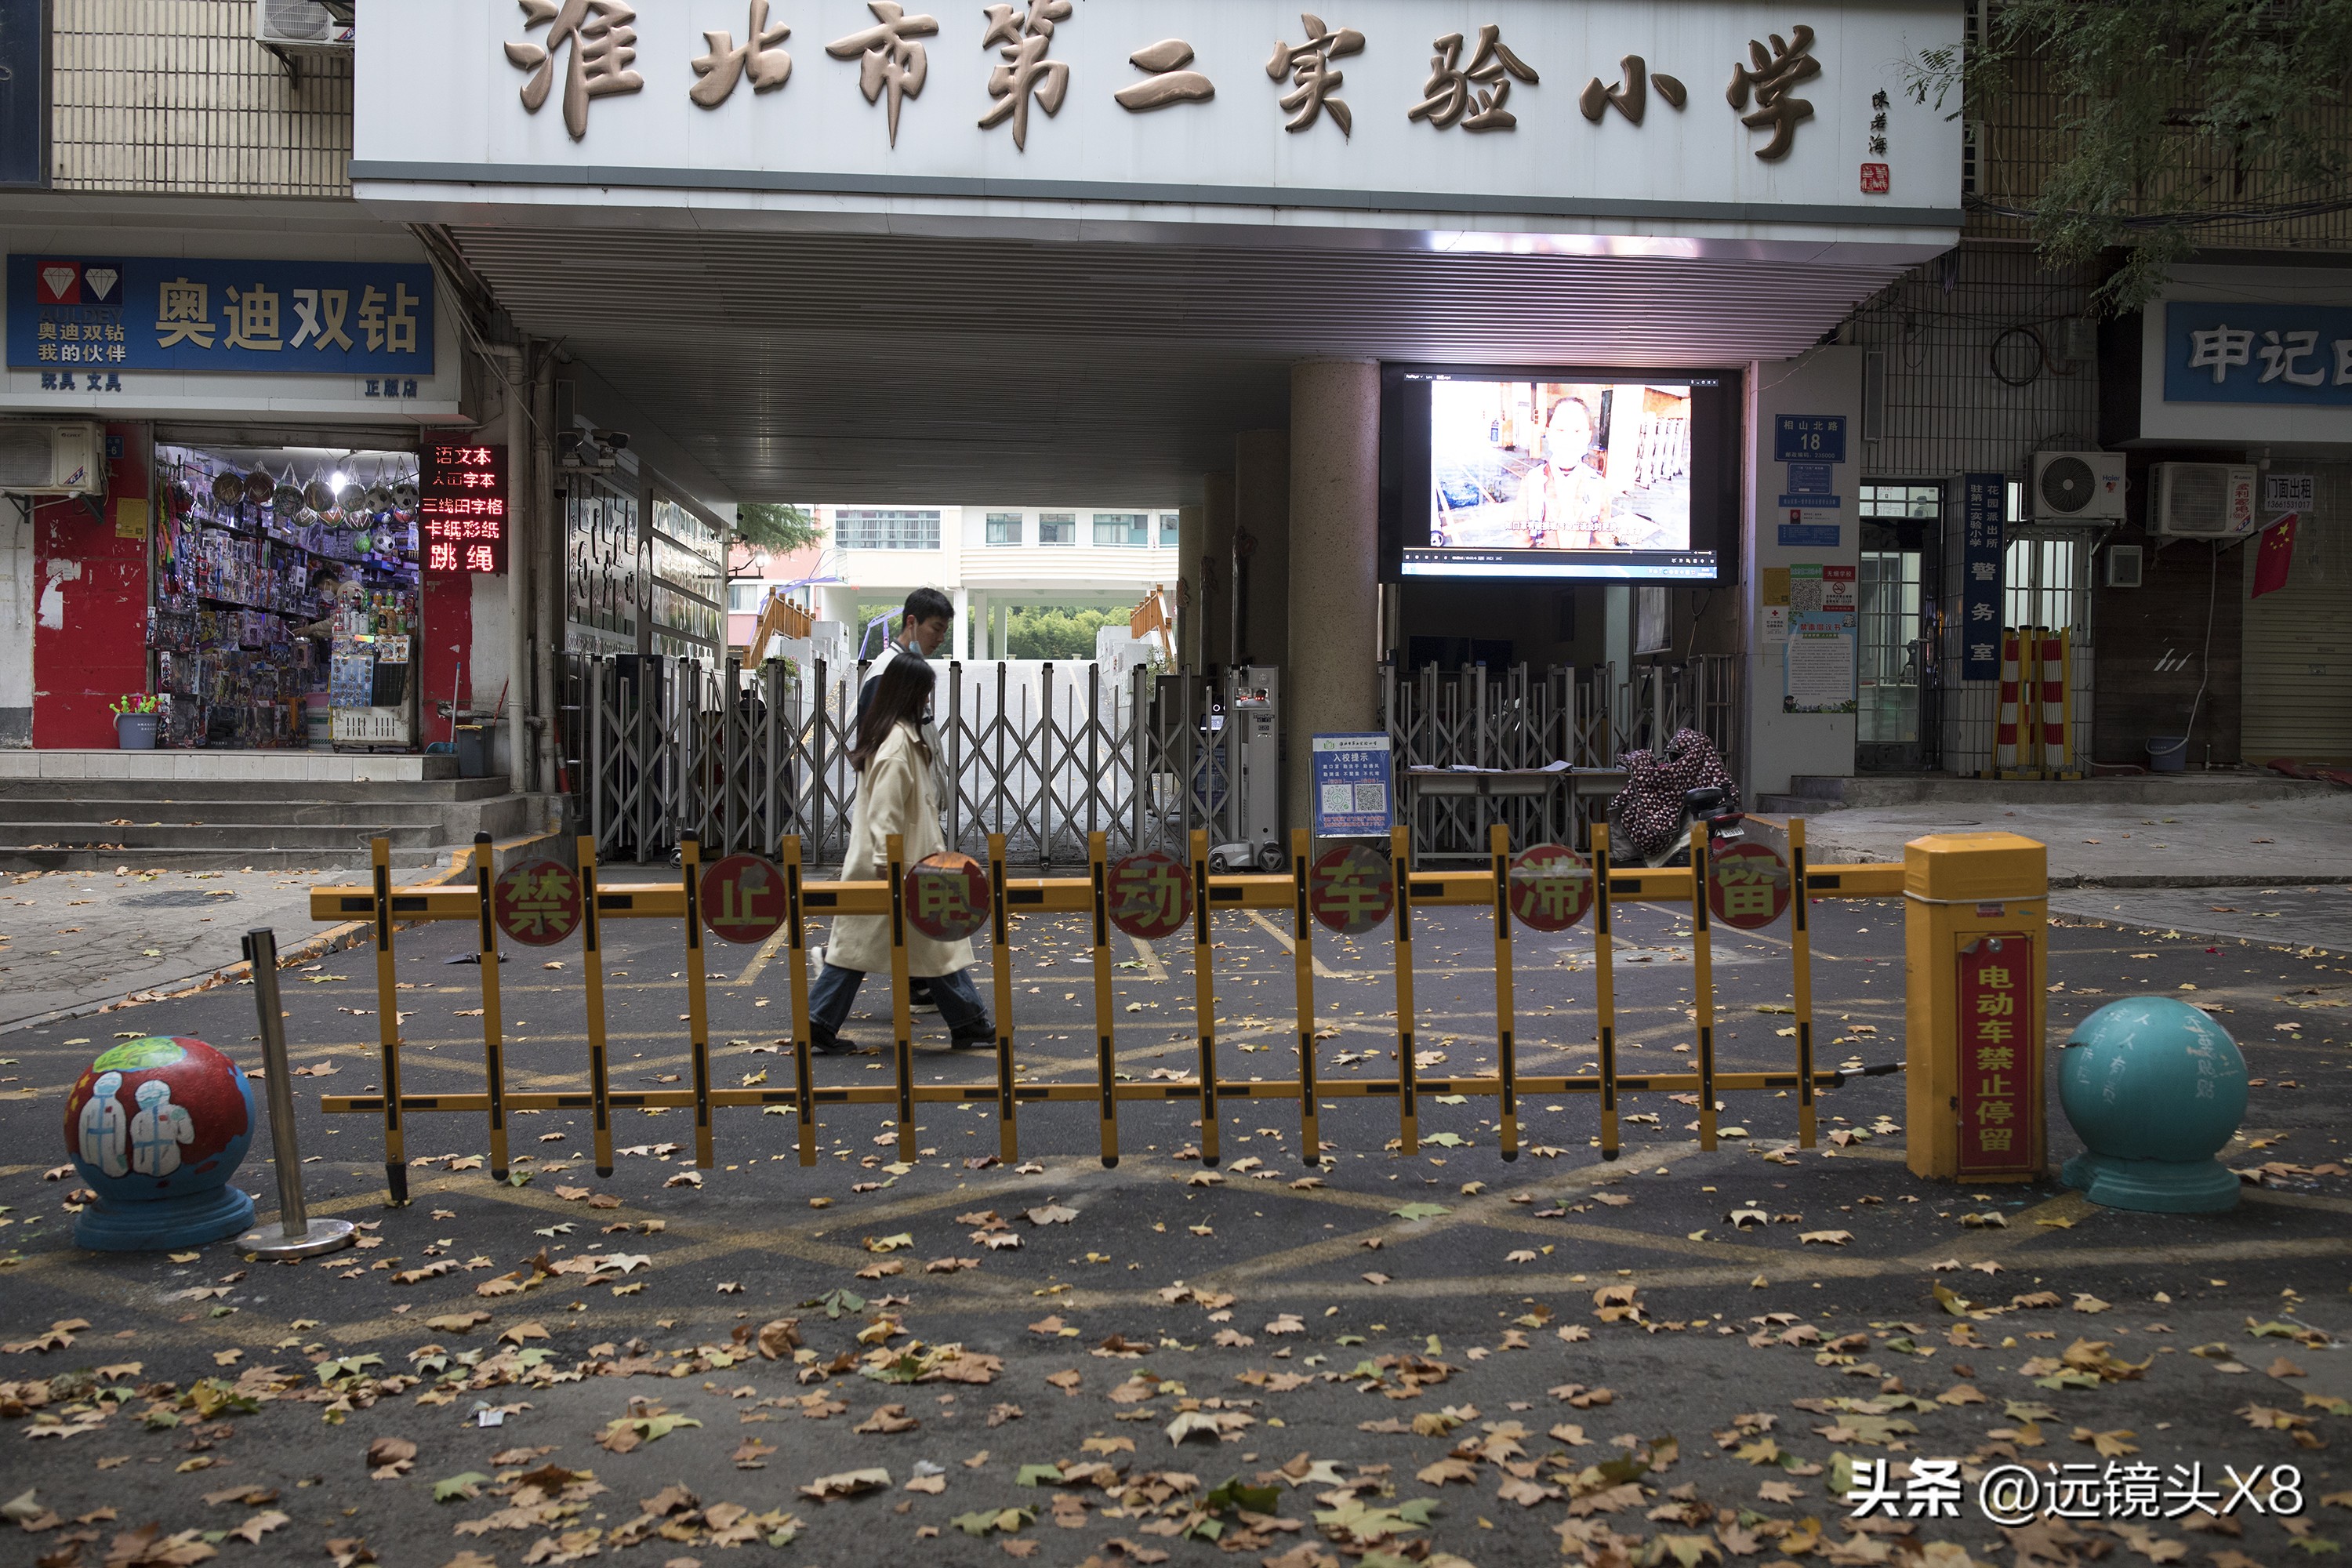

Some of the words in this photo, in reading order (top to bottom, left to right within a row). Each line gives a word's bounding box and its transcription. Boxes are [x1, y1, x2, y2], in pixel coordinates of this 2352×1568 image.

[503, 0, 1822, 158] 淮北市第二实验小学
[38, 307, 124, 325] AULDEY
[155, 277, 420, 354] 奥迪双钻
[38, 322, 125, 342] 奥迪双钻
[38, 343, 125, 363] 我的伙伴
[41, 371, 75, 390] 玩具
[87, 371, 122, 392] 文具
[365, 379, 418, 398] 正版店
[1784, 419, 1838, 431] 相山北路
[1800, 433, 1820, 451] 18
[2267, 477, 2312, 499] 门面出租
[422, 497, 503, 515] 三线田字格
[1969, 483, 1984, 547] 驻第二实验小学
[2267, 500, 2310, 509] 13661531017
[1986, 484, 2000, 549] 花园派出所
[424, 519, 499, 540] 卡纸彩纸
[430, 542, 494, 572] 跳绳
[1970, 561, 1997, 662] 警务室
[1333, 753, 1369, 762] 入校提示
[1976, 964, 2015, 1152] 电动车禁止停留
